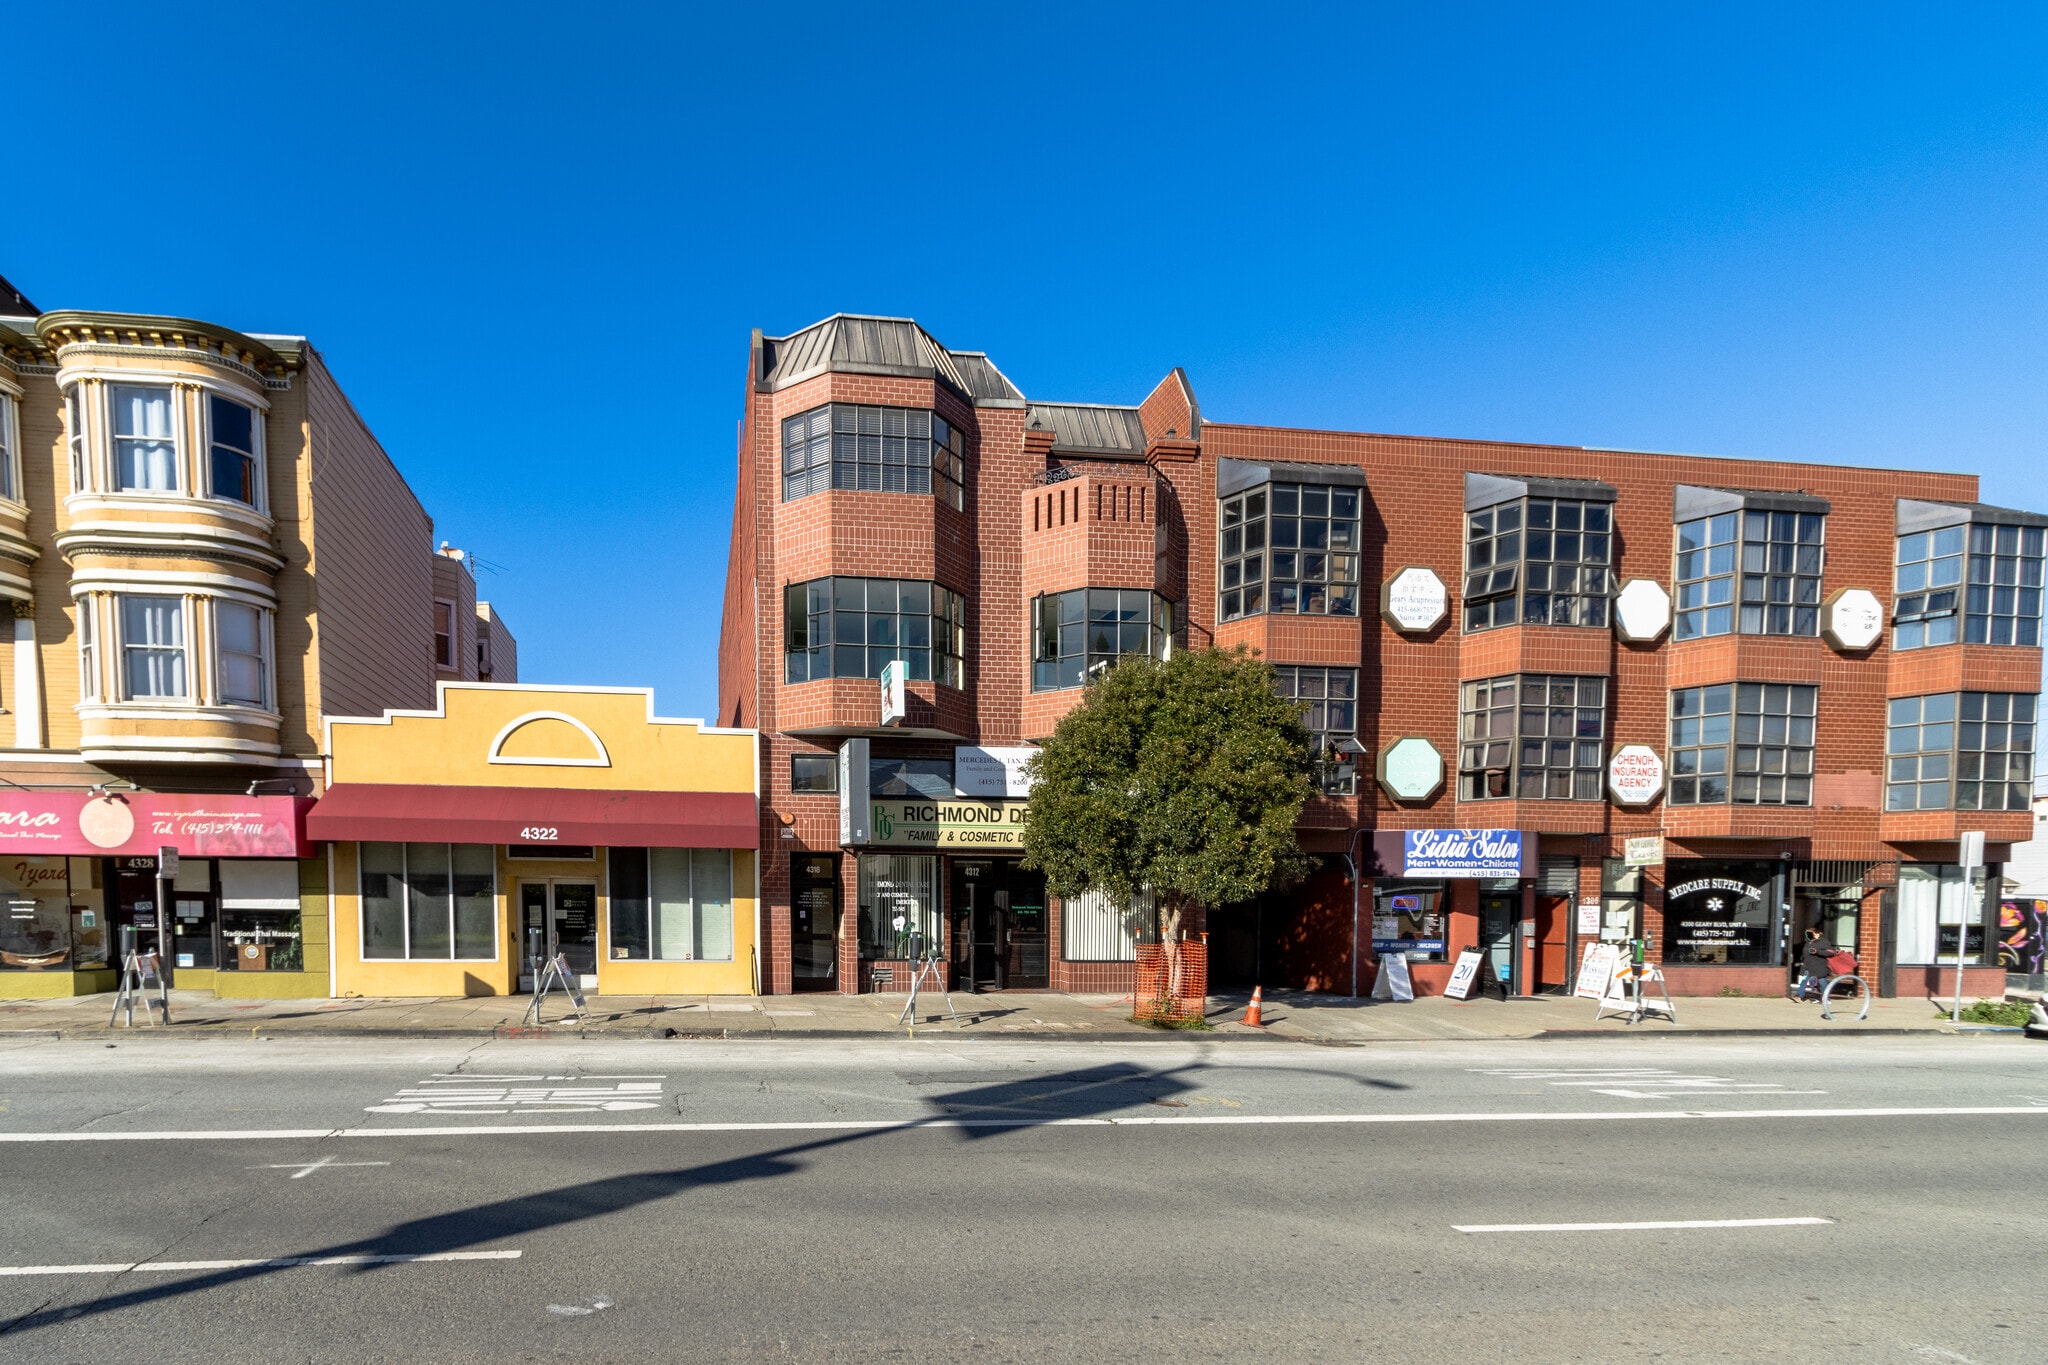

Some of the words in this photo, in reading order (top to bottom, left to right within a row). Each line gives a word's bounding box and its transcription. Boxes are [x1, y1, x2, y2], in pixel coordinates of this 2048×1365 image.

[959, 756, 998, 764] MERCEDES
[1617, 754, 1654, 766] CHENOH
[1612, 766, 1659, 777] INSURANCE
[978, 778, 995, 786] (415)
[1618, 777, 1652, 788] AGENCY
[903, 805, 1001, 823] RICHMOND
[152, 821, 174, 835] Tel.
[520, 826, 559, 841] 4322
[959, 831, 1014, 843] COSMETIC
[1406, 829, 1471, 859] Lidia
[1472, 829, 1520, 859] Salon
[128, 858, 155, 869] 4328
[14, 861, 67, 887] Iyara
[965, 867, 980, 877] 4312
[1469, 870, 1488, 878] (415)
[1668, 879, 1711, 900] MEDCARE
[1712, 879, 1745, 895] SUPPLY,
[1745, 885, 1762, 901] INC.
[1394, 898, 1417, 908] OPEN
[223, 930, 256, 938] Traditional
[257, 930, 271, 938] Thai
[271, 930, 300, 940] Massage
[1677, 938, 1751, 946] www.medcaremart.biz
